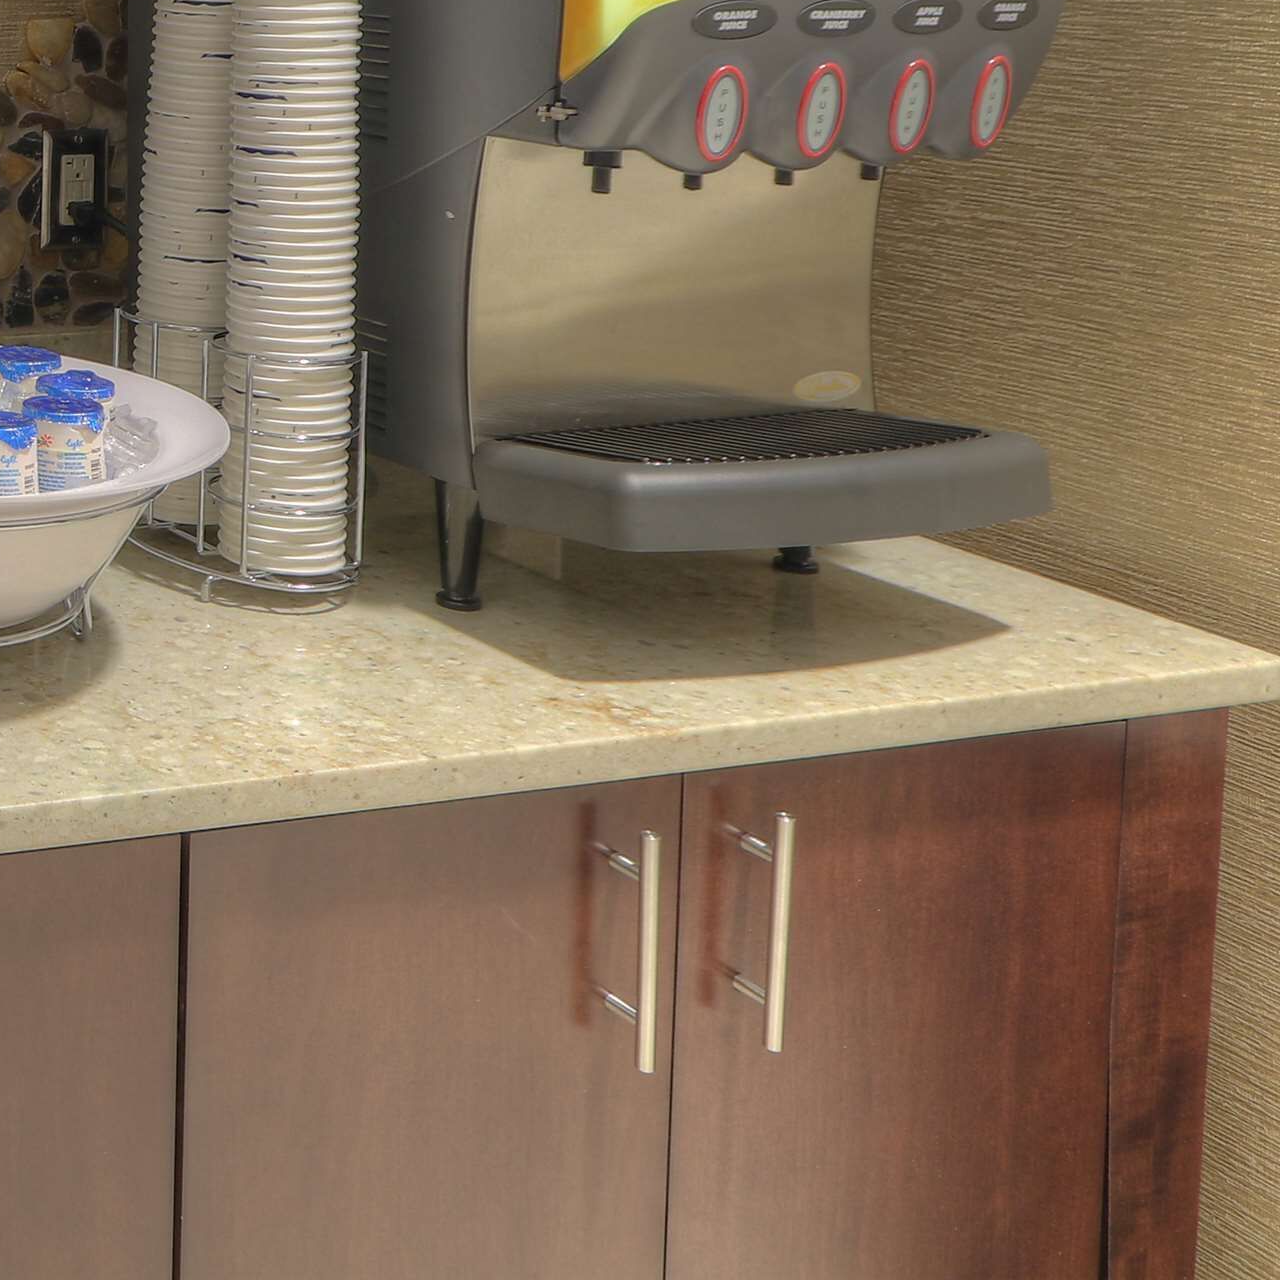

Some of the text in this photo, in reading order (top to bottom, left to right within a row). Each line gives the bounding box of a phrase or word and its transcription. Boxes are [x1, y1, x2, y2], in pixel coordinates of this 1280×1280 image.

[712, 10, 760, 20] ORANGE
[809, 9, 867, 20] CRANBERRY
[915, 6, 945, 16] APPLE
[718, 21, 749, 31] JUICE
[821, 20, 850, 30] JUICE
[713, 87, 730, 141] PUSH
[814, 85, 830, 137] PUSH
